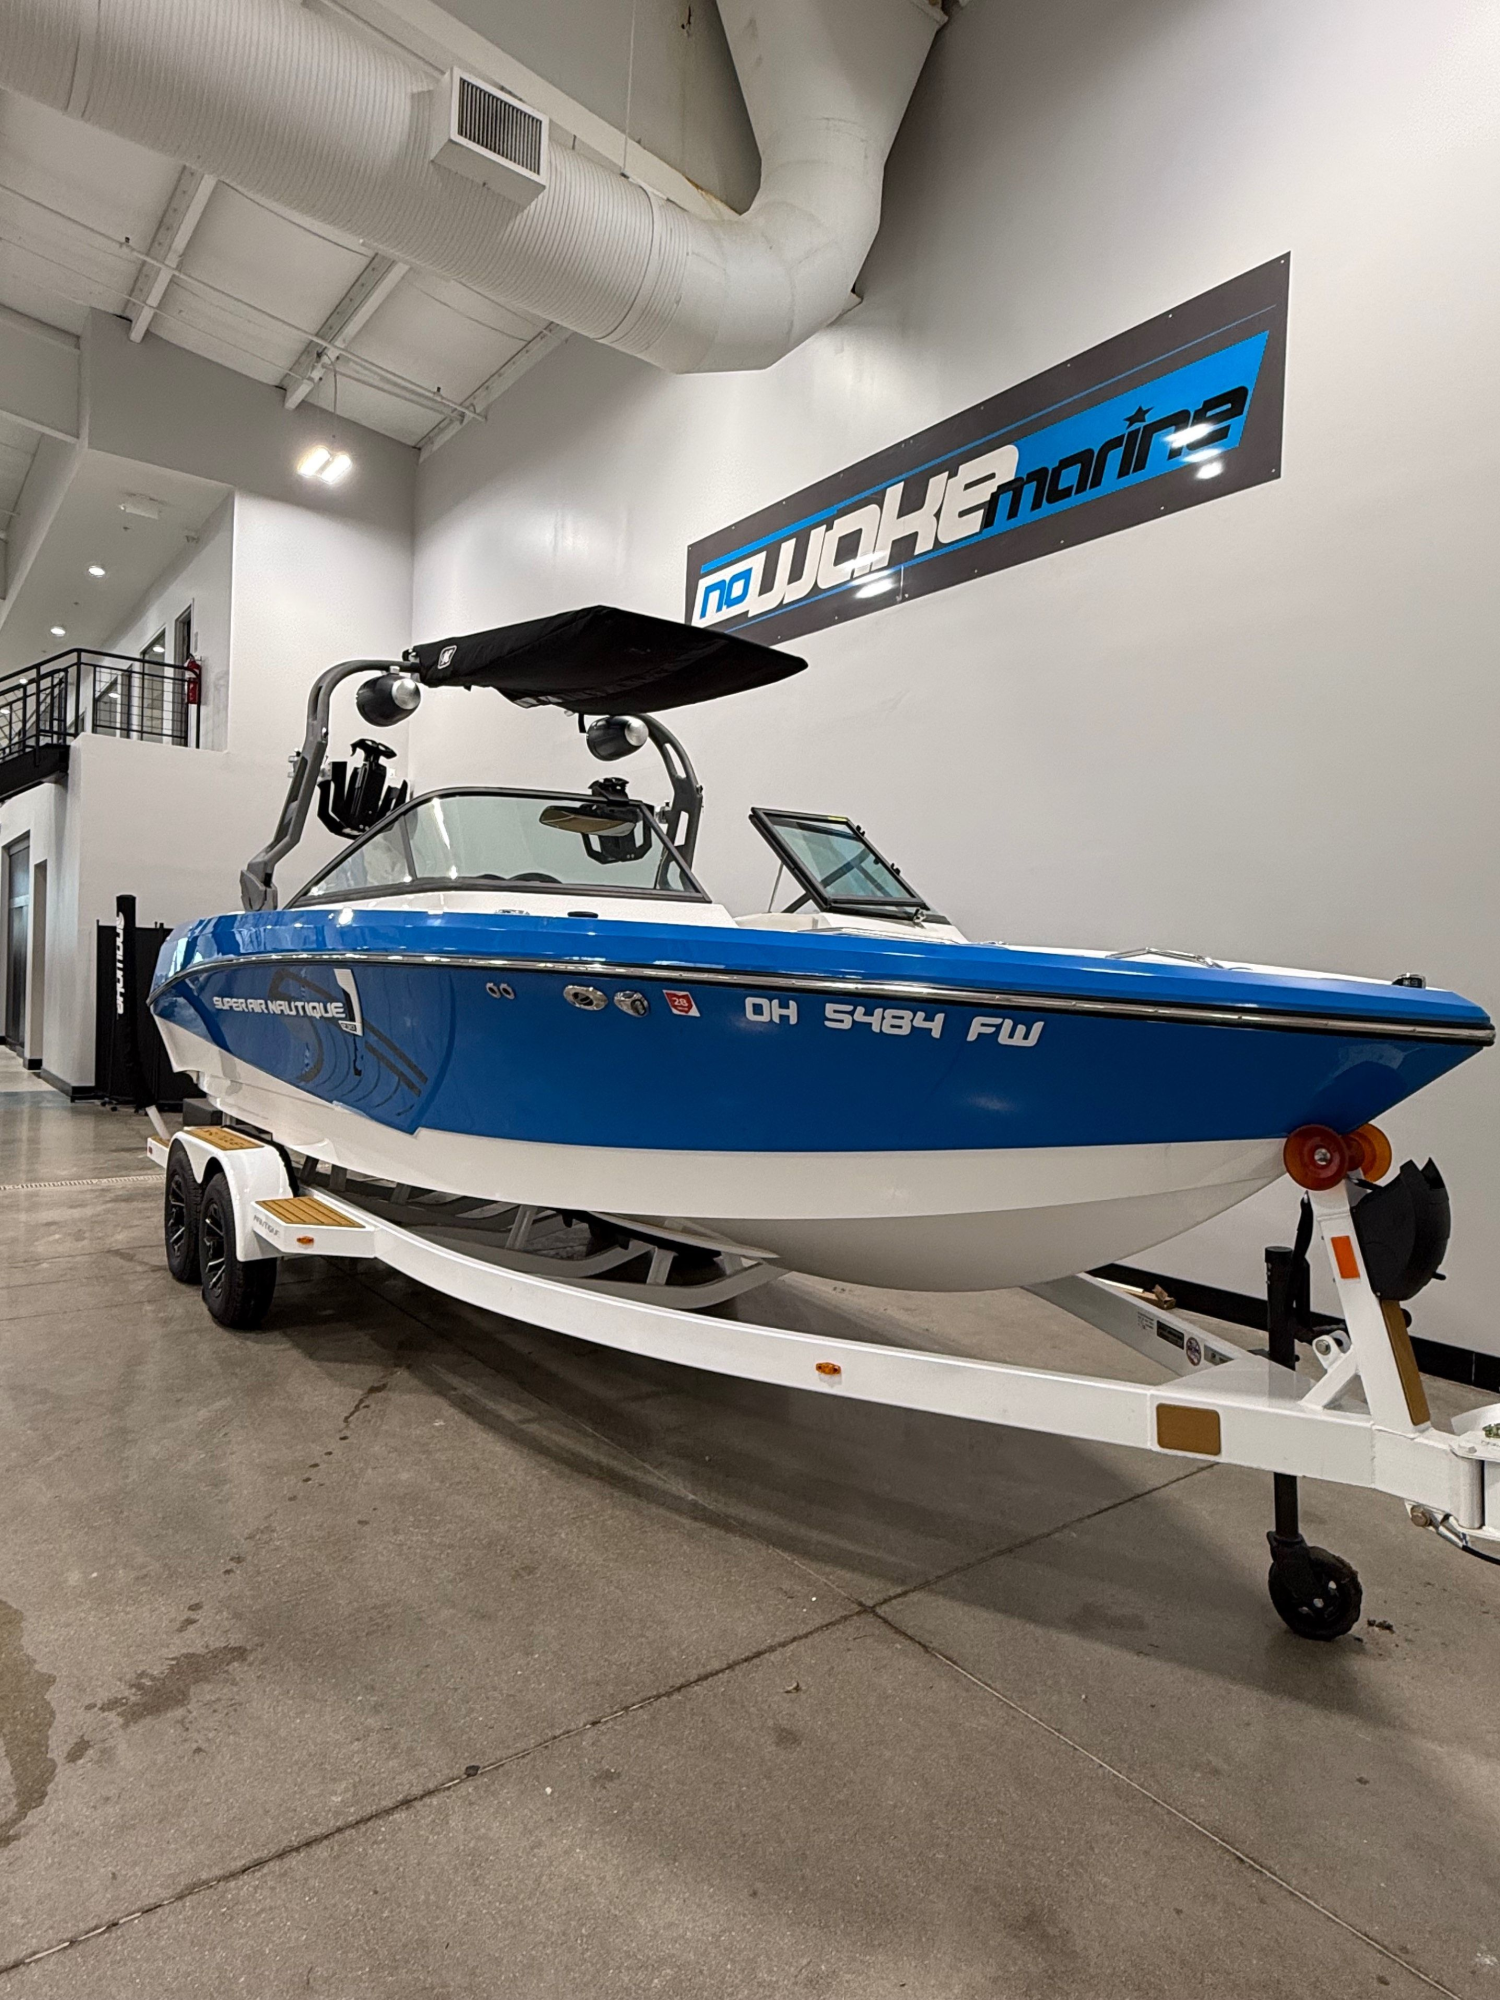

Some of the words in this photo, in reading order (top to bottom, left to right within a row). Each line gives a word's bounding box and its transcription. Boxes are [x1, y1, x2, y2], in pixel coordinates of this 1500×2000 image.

[983, 385, 1249, 529] marine
[213, 997, 248, 1012] SUPER
[247, 999, 268, 1013] AIR
[267, 1001, 346, 1019] NAUTIQUE
[744, 996, 798, 1025] OH
[823, 1002, 945, 1039] 5484
[966, 1016, 1044, 1047] FW
